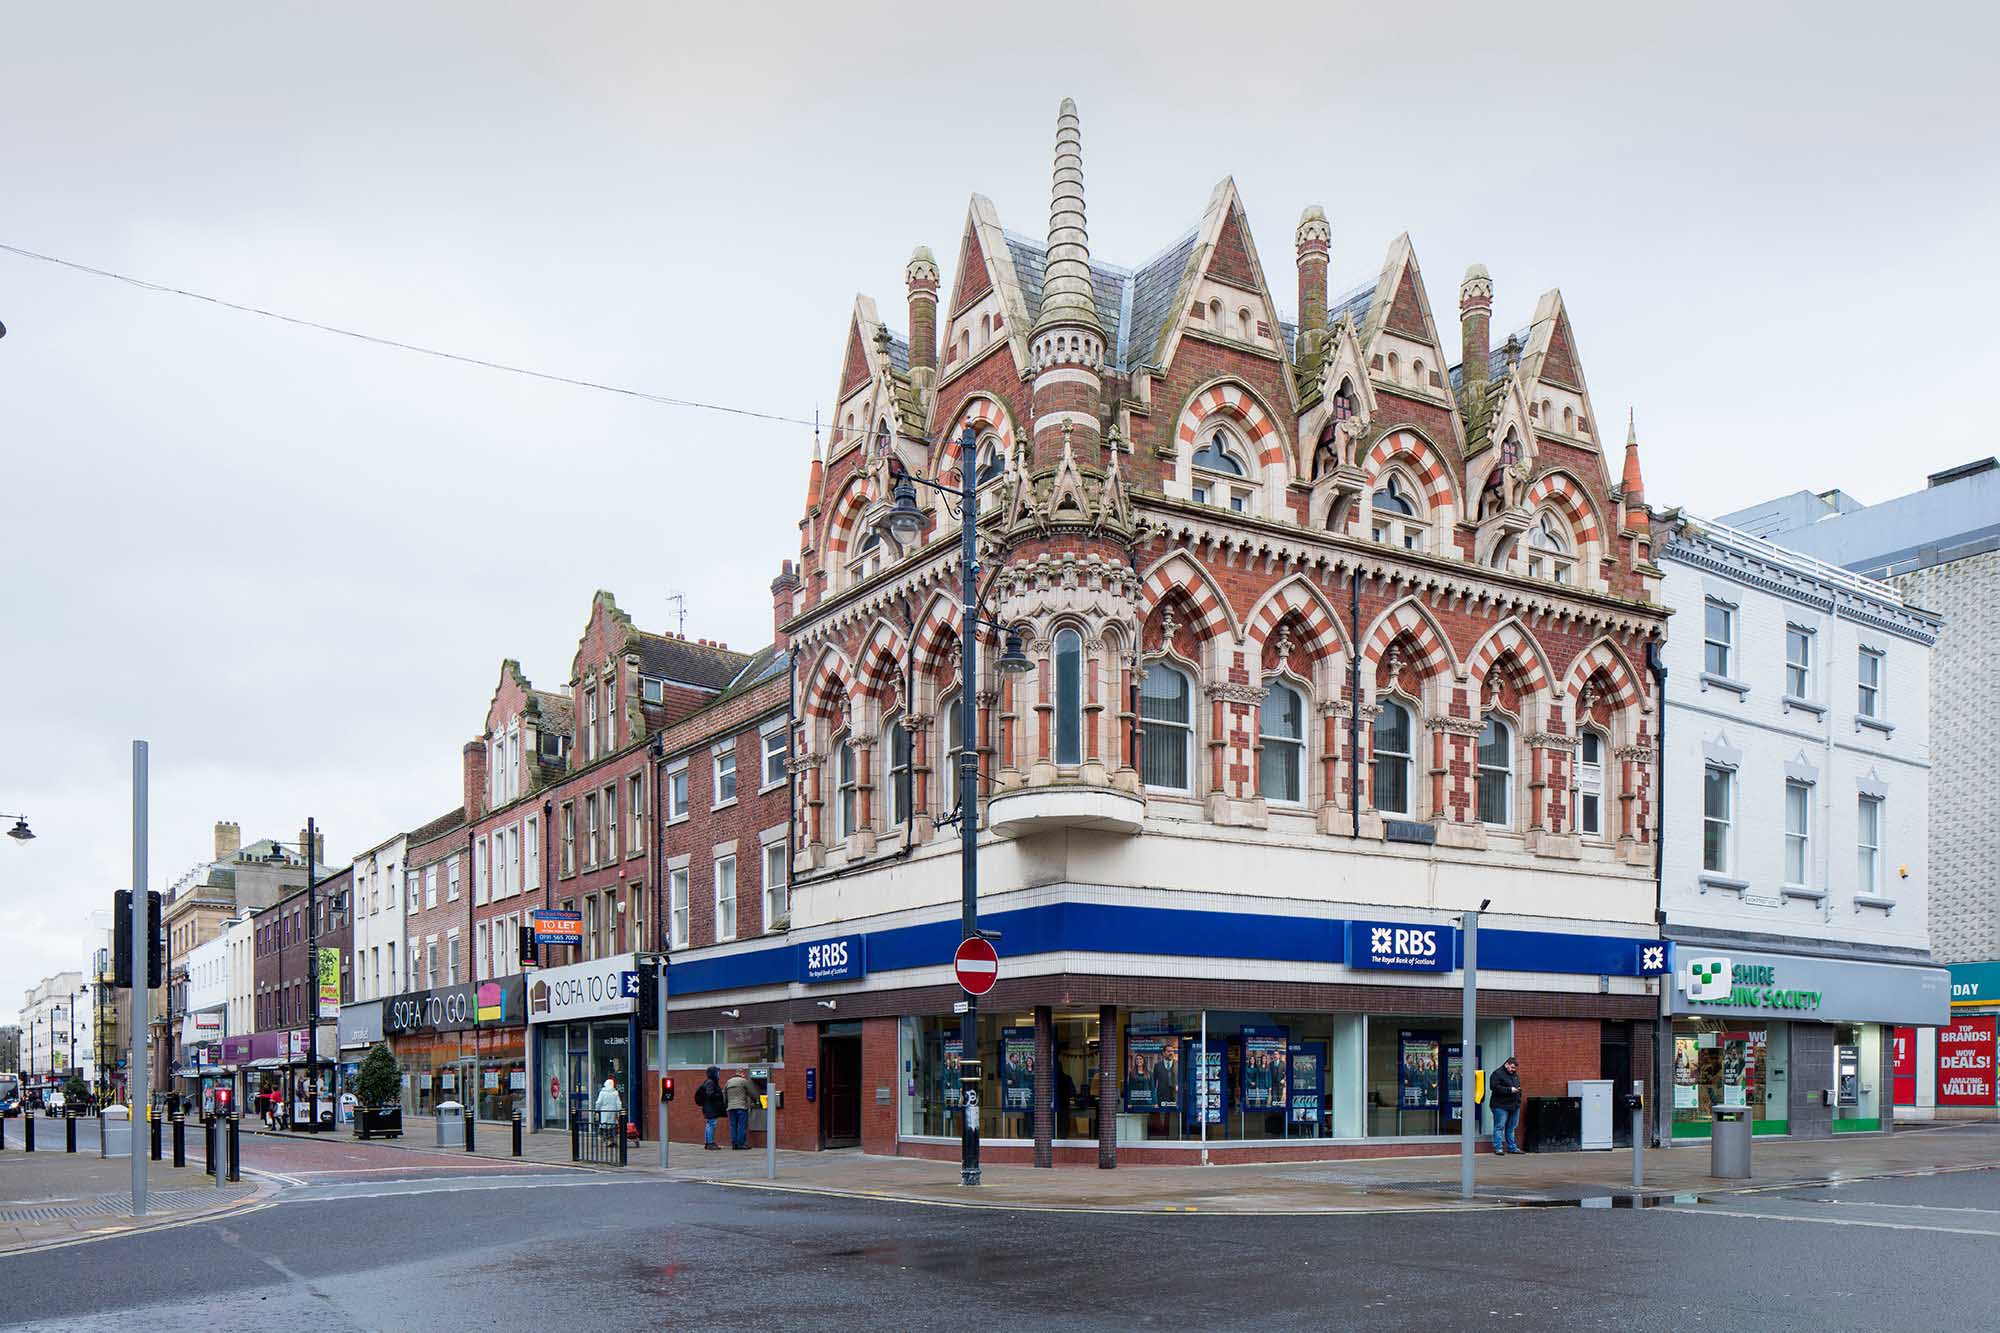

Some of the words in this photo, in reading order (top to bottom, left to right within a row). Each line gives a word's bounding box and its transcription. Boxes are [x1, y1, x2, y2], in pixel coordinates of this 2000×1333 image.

[543, 921, 556, 929] TO
[558, 921, 576, 929] LET
[1395, 928, 1437, 956] RBS
[822, 941, 848, 967] RBS
[1382, 956, 1396, 965] Royal
[1408, 957, 1415, 965] of
[1414, 957, 1436, 966] Scotland
[1732, 964, 1775, 984] SHIRE
[555, 979, 584, 1006] SOFA
[587, 976, 603, 1002] TO
[1950, 984, 1979, 996] DAY
[1762, 988, 1822, 1009] SOCIETY
[393, 1000, 422, 1029] SOFA
[426, 996, 442, 1025] TO
[446, 993, 467, 1023] GO
[1941, 1031, 1991, 1042] BRANDS!
[1955, 1049, 1976, 1057] WOW
[1941, 1056, 1991, 1069] DEALS!
[1942, 1083, 1990, 1095] VALUE!
